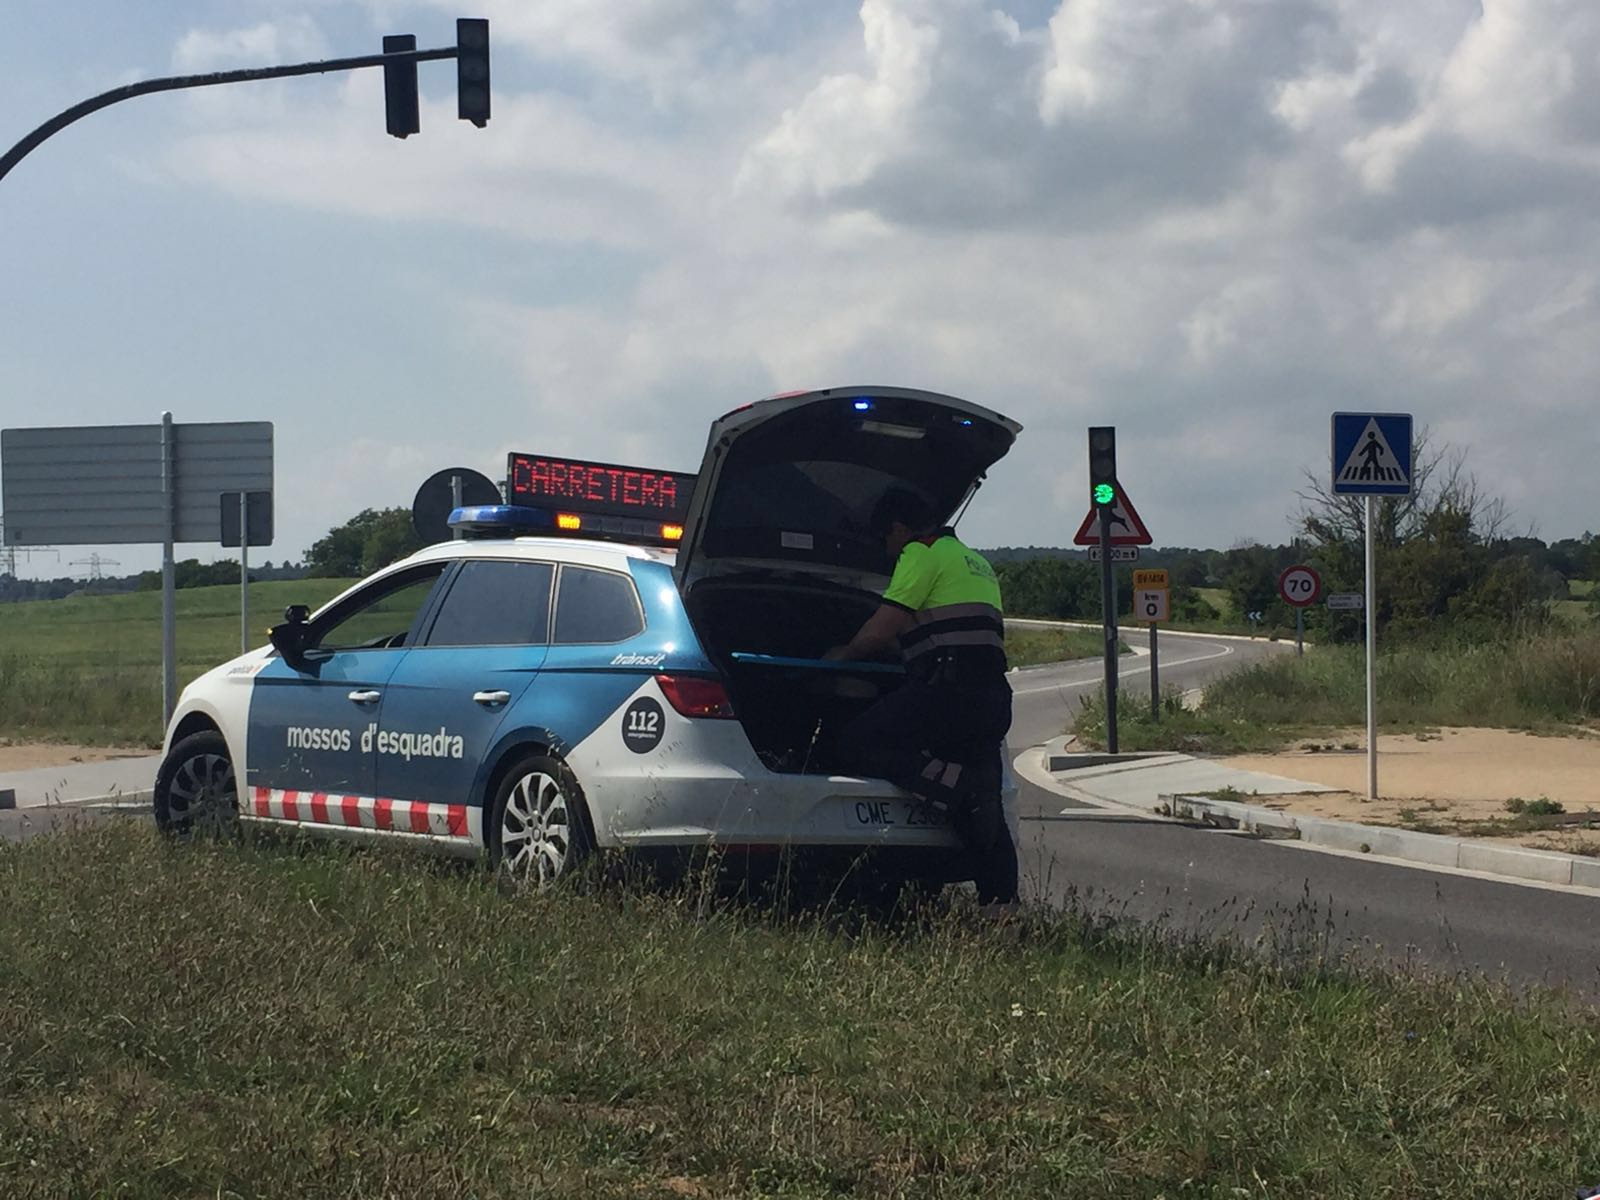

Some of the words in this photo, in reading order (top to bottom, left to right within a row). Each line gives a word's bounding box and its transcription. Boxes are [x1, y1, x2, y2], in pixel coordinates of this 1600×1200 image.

[515, 458, 676, 507] CARRETERA
[1144, 592, 1159, 601] km
[1288, 579, 1313, 594] 70
[628, 710, 660, 732] 112
[286, 726, 350, 752] mossos
[361, 722, 464, 761] d'esquadra
[855, 802, 894, 824] CME
